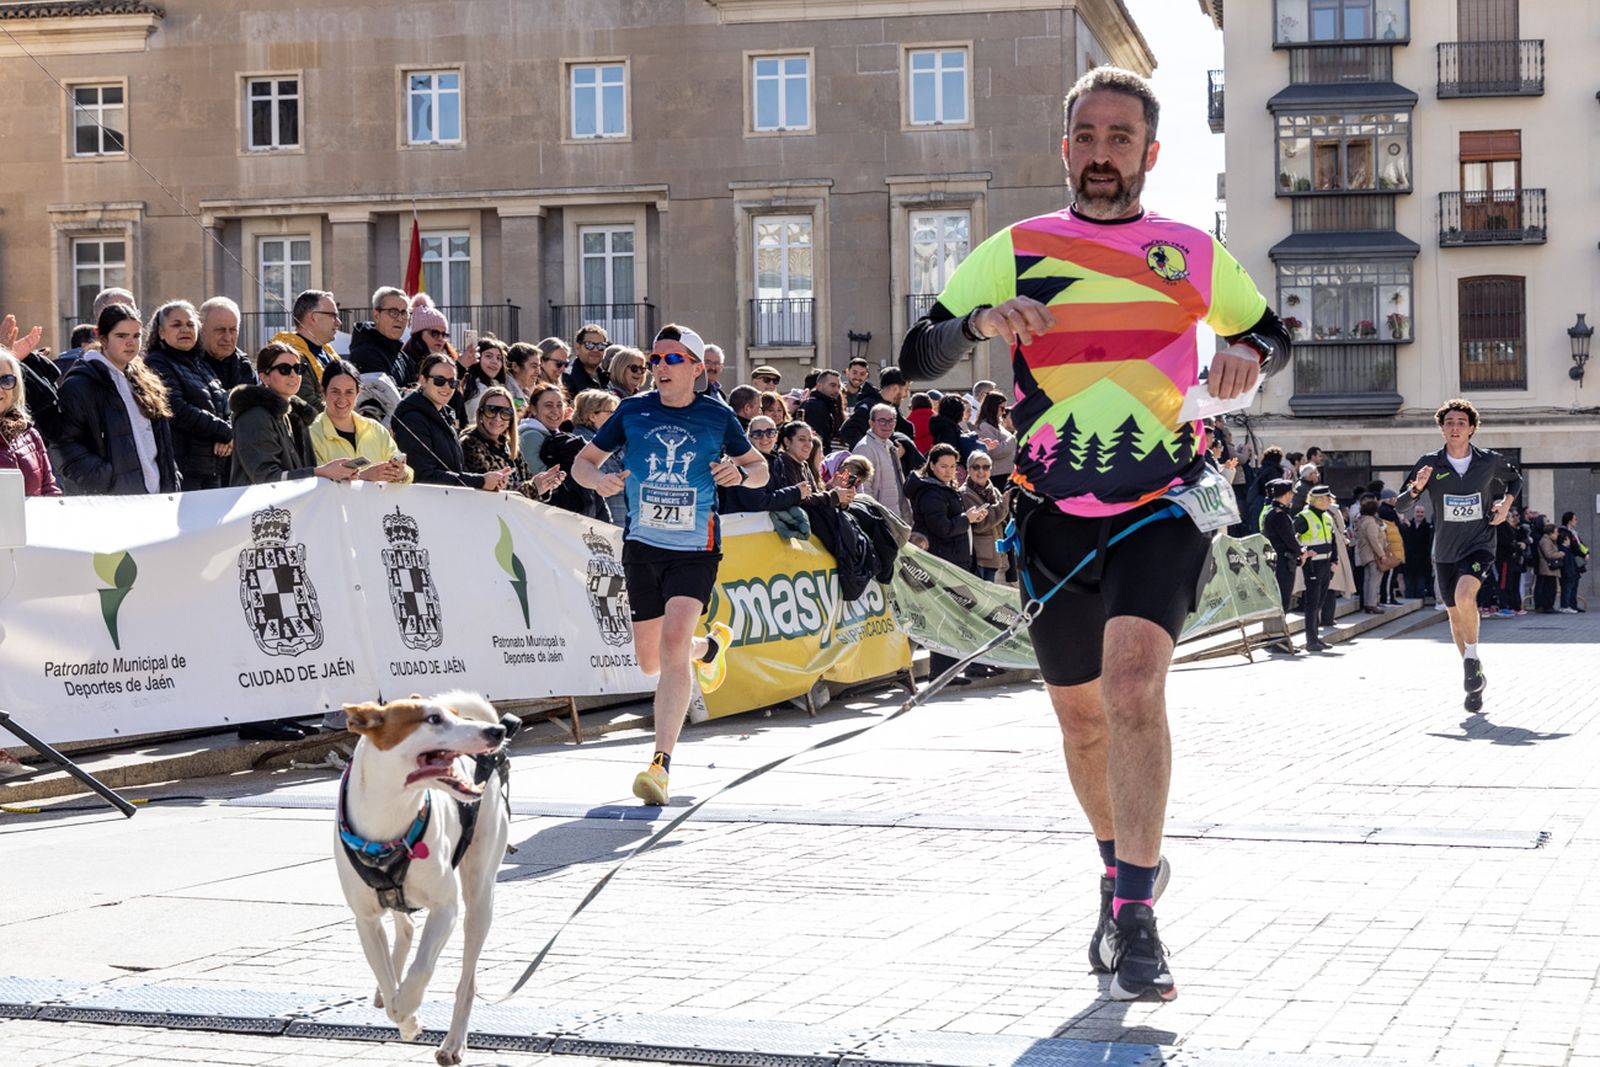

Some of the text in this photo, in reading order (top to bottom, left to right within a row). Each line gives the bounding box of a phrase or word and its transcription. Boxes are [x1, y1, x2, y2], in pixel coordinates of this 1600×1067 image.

[652, 505, 680, 521] 271
[1453, 506, 1474, 517] 626
[492, 635, 525, 649] Patronato
[526, 635, 558, 648] Municipal
[44, 653, 187, 678] Patronato Municipal de
[503, 650, 564, 665] Deportes de Jaén
[590, 655, 621, 669] CIUDAD
[622, 654, 632, 668] DE
[238, 659, 356, 689] CIUDAD DE JAÉN
[390, 655, 466, 677] CIUDAD DE JAÉN
[64, 675, 175, 699] Deportes de Jaén
